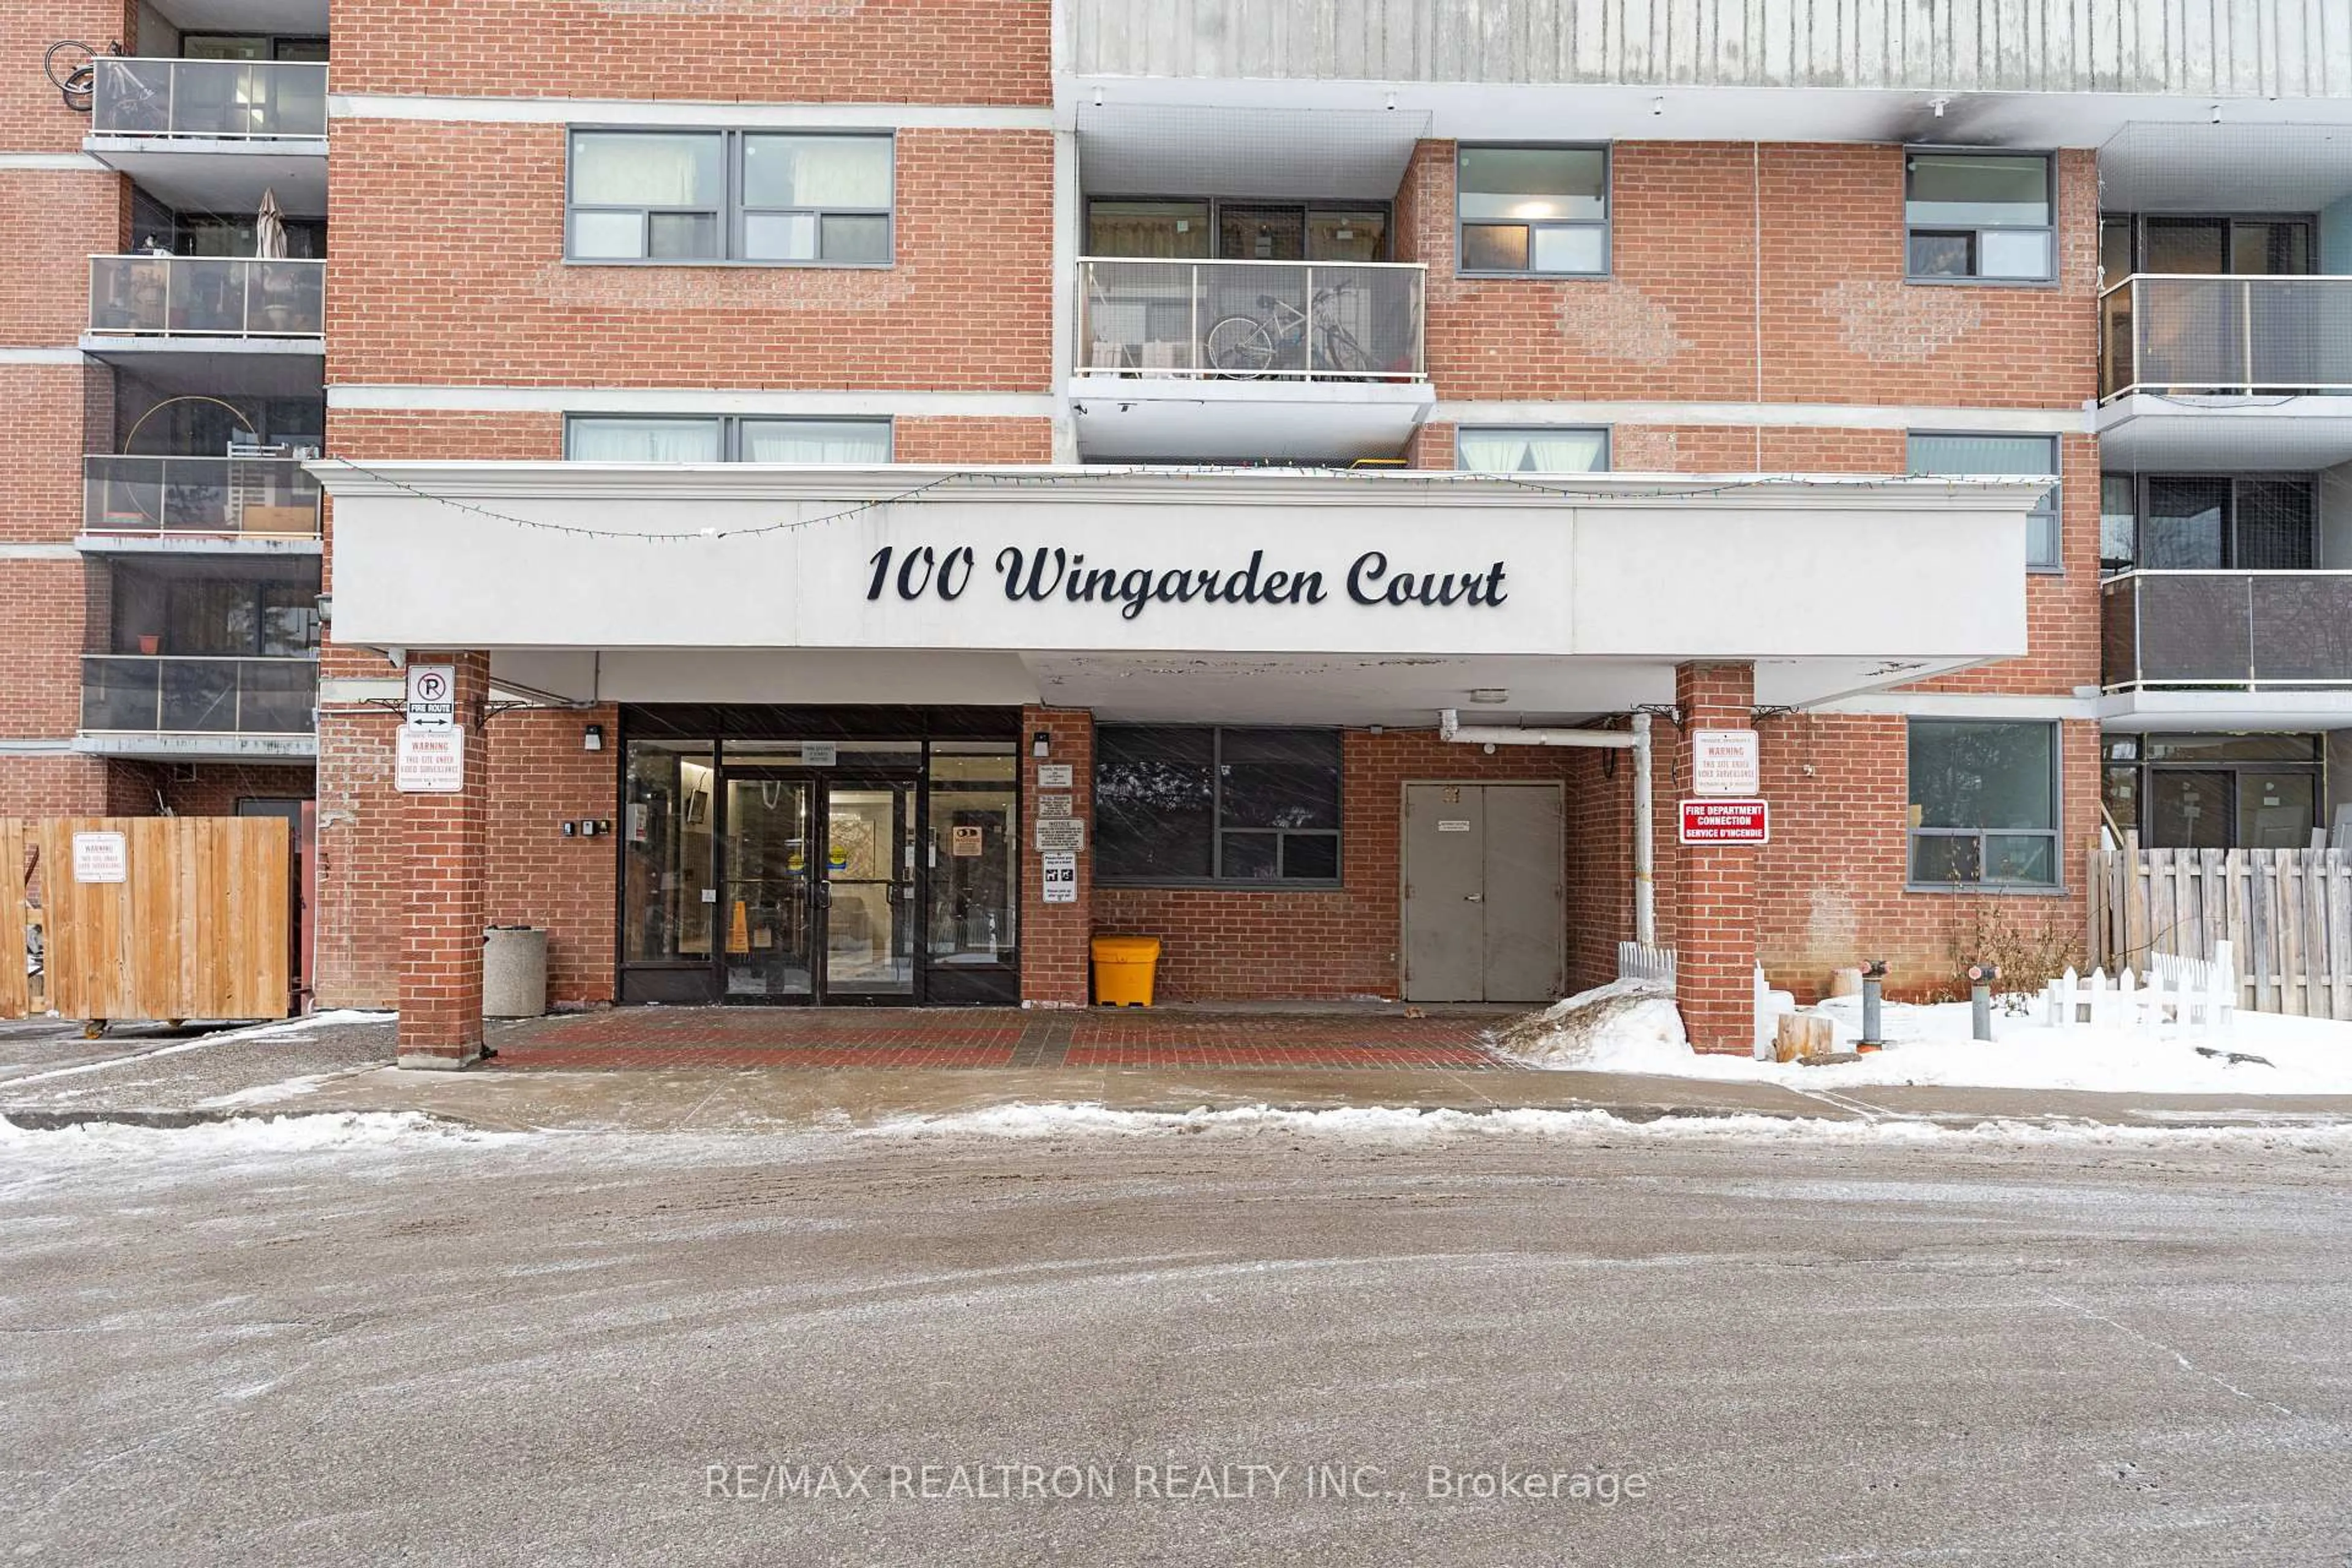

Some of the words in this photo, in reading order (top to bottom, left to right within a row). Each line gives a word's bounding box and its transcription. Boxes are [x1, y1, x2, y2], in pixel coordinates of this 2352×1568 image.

[867, 546, 974, 601] 100
[995, 546, 1327, 620] Wingarden
[1346, 551, 1508, 607] Court
[411, 704, 426, 713] FIRE
[428, 704, 451, 713] ROUTE
[412, 742, 449, 751] WARNING
[1708, 747, 1744, 756] WARNING
[1686, 806, 1705, 815] FIRE
[1708, 806, 1763, 815] DEPARTMENT
[1697, 816, 1752, 825] CONNECTION
[1686, 829, 1718, 837] SERVICE
[1720, 829, 1763, 837] D'INCENDIE
